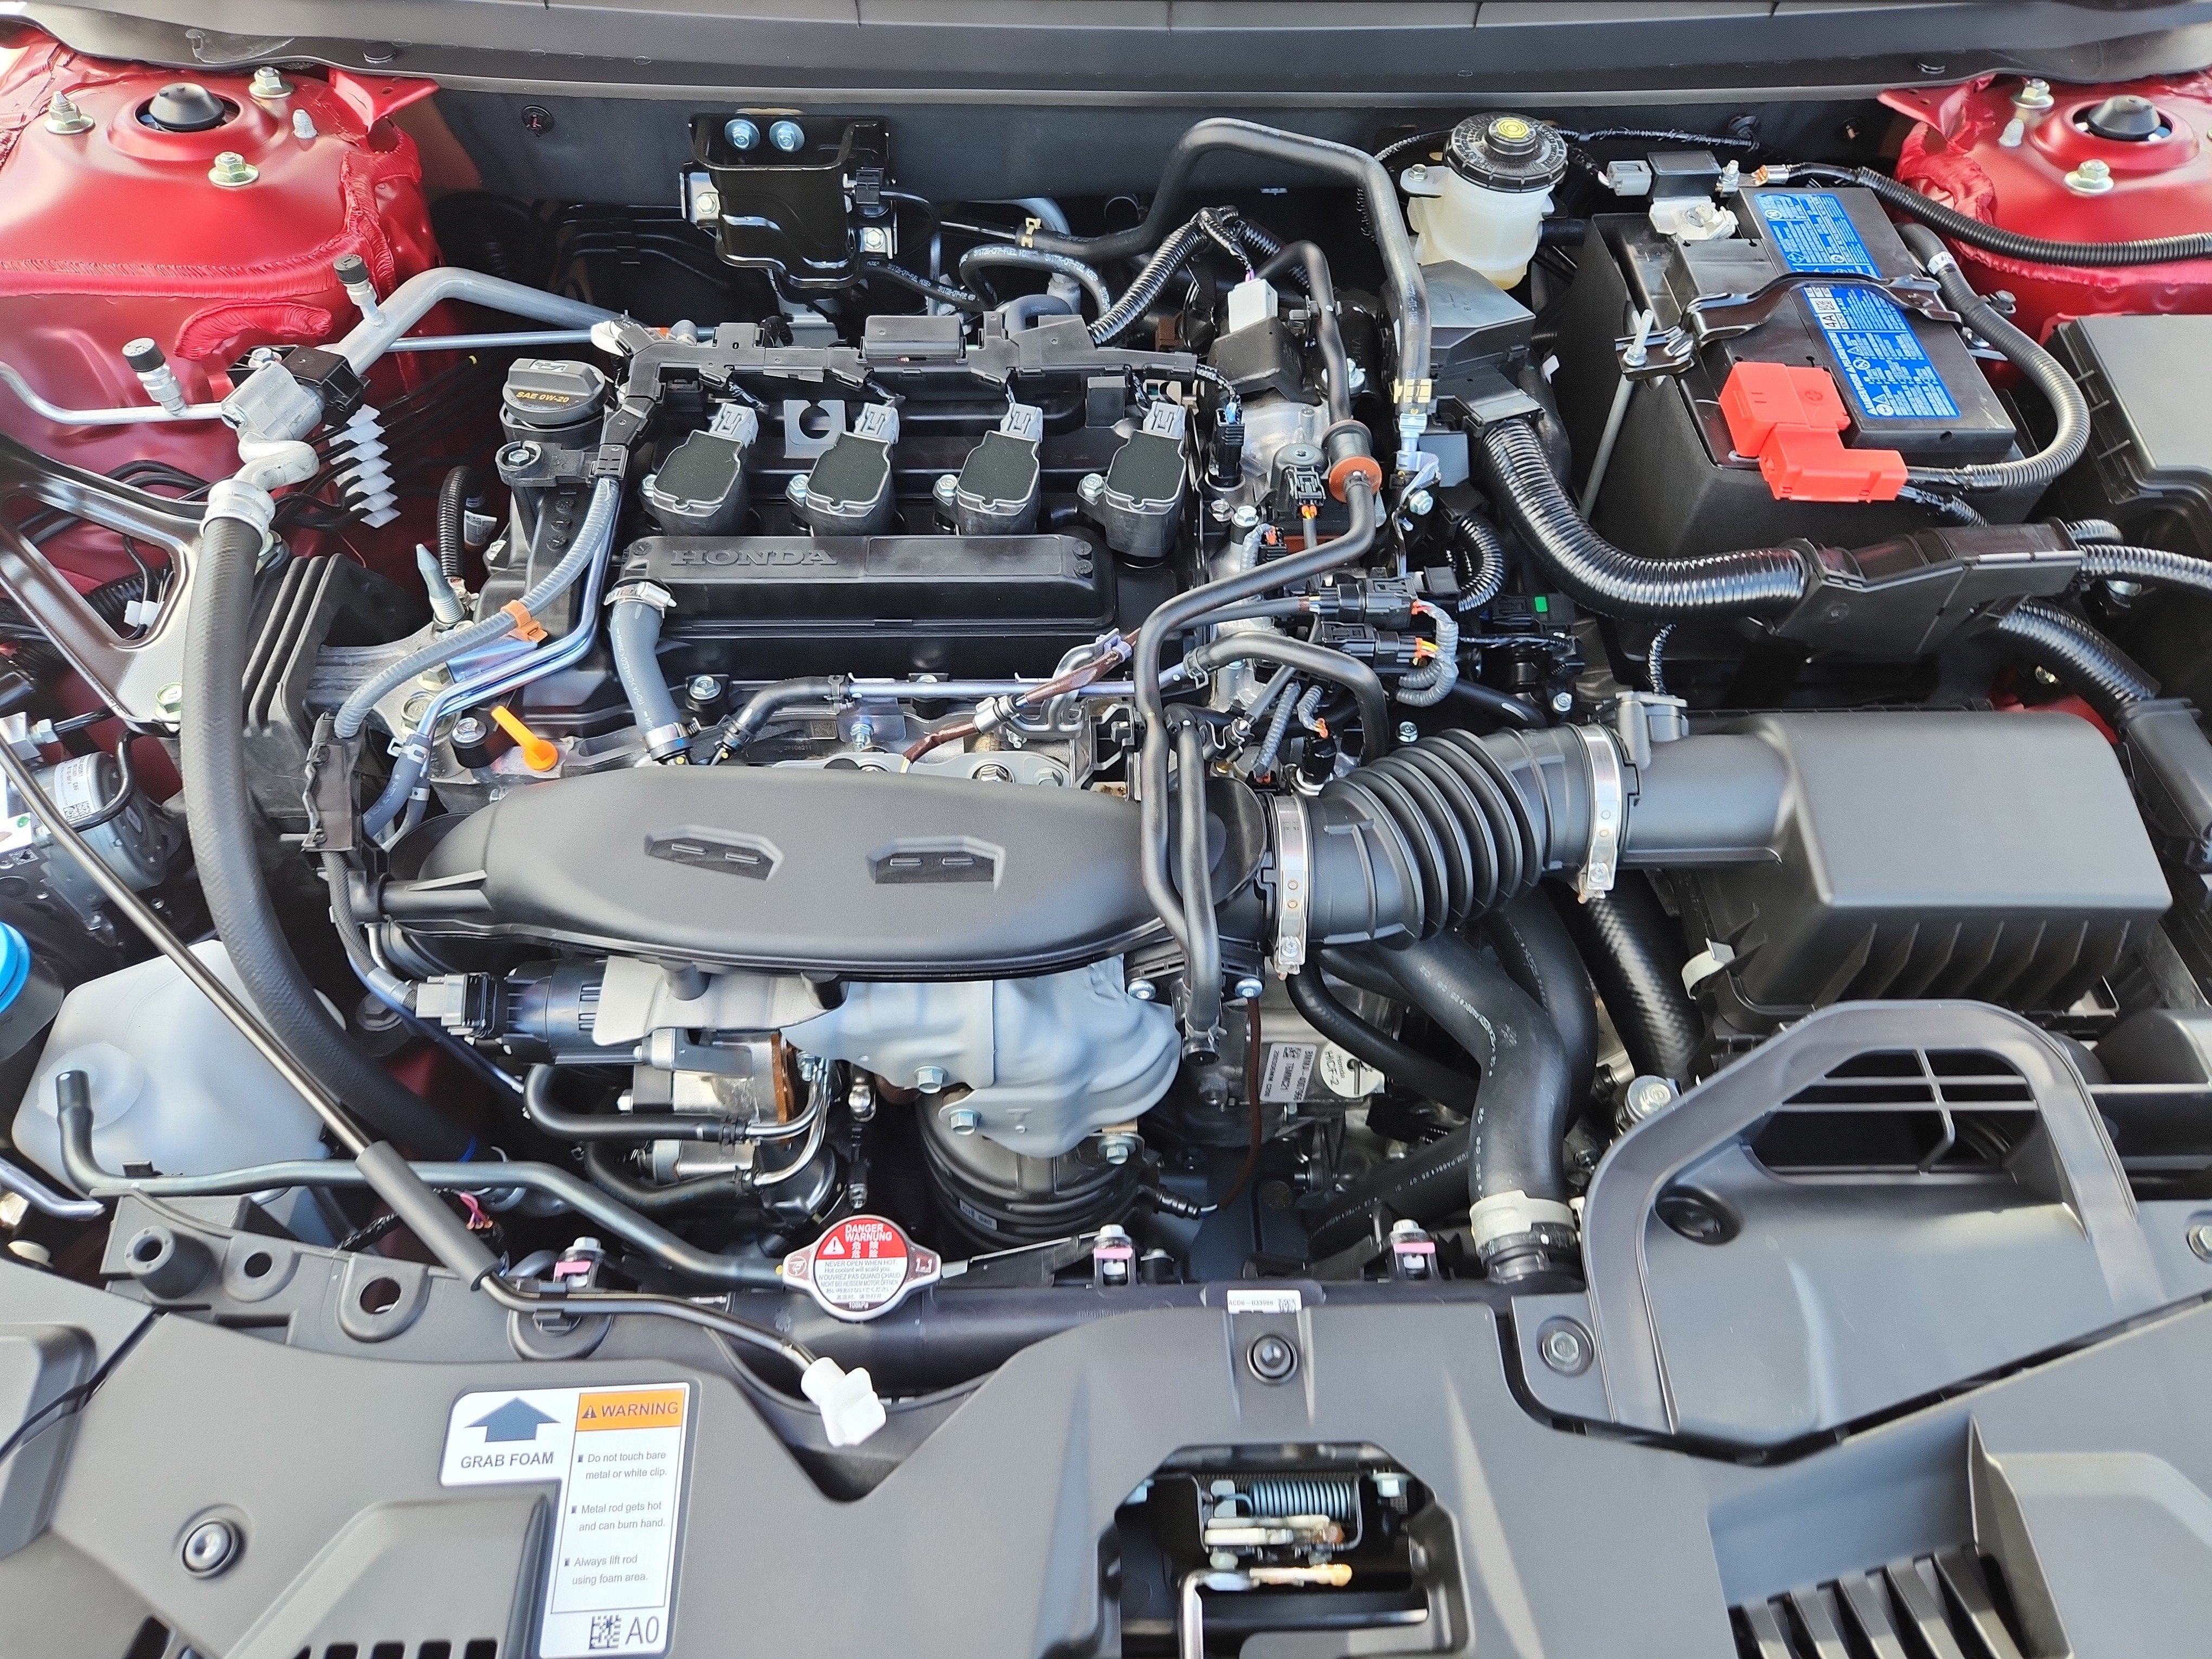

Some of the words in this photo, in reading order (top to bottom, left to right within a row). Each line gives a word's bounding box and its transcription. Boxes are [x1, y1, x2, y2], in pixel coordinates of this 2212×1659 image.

[1822, 314, 1837, 329] 4A
[516, 391, 538, 400] SAE
[539, 391, 570, 403] 0W-20
[671, 549, 838, 566] HONDA
[1324, 1050, 1340, 1086] HCF-2
[1336, 1053, 1346, 1079] Honda
[846, 1224, 884, 1233] DANGER
[845, 1232, 892, 1242] WARNUNG
[602, 1402, 678, 1417] WARNING
[461, 1454, 505, 1469] GRAB
[510, 1451, 554, 1466] FOAM
[588, 1453, 600, 1462] Do
[603, 1452, 617, 1462] not
[619, 1451, 644, 1461] touch
[646, 1451, 666, 1460] bare
[586, 1470, 609, 1480] metal
[624, 1468, 648, 1477] white
[650, 1467, 667, 1478] clip.
[581, 1504, 606, 1514] Metal
[609, 1503, 623, 1513] rod
[626, 1504, 645, 1514] gets
[647, 1501, 661, 1511] hot
[579, 1521, 596, 1531] and
[599, 1522, 615, 1530] can
[617, 1520, 638, 1529] burn
[641, 1518, 665, 1528] hand.
[574, 1557, 607, 1569] Always
[609, 1555, 621, 1565] lift
[623, 1554, 638, 1564] rod
[572, 1574, 596, 1586] using
[599, 1573, 623, 1583] foam
[625, 1573, 648, 1582] area.
[625, 1616, 659, 1645] A0
